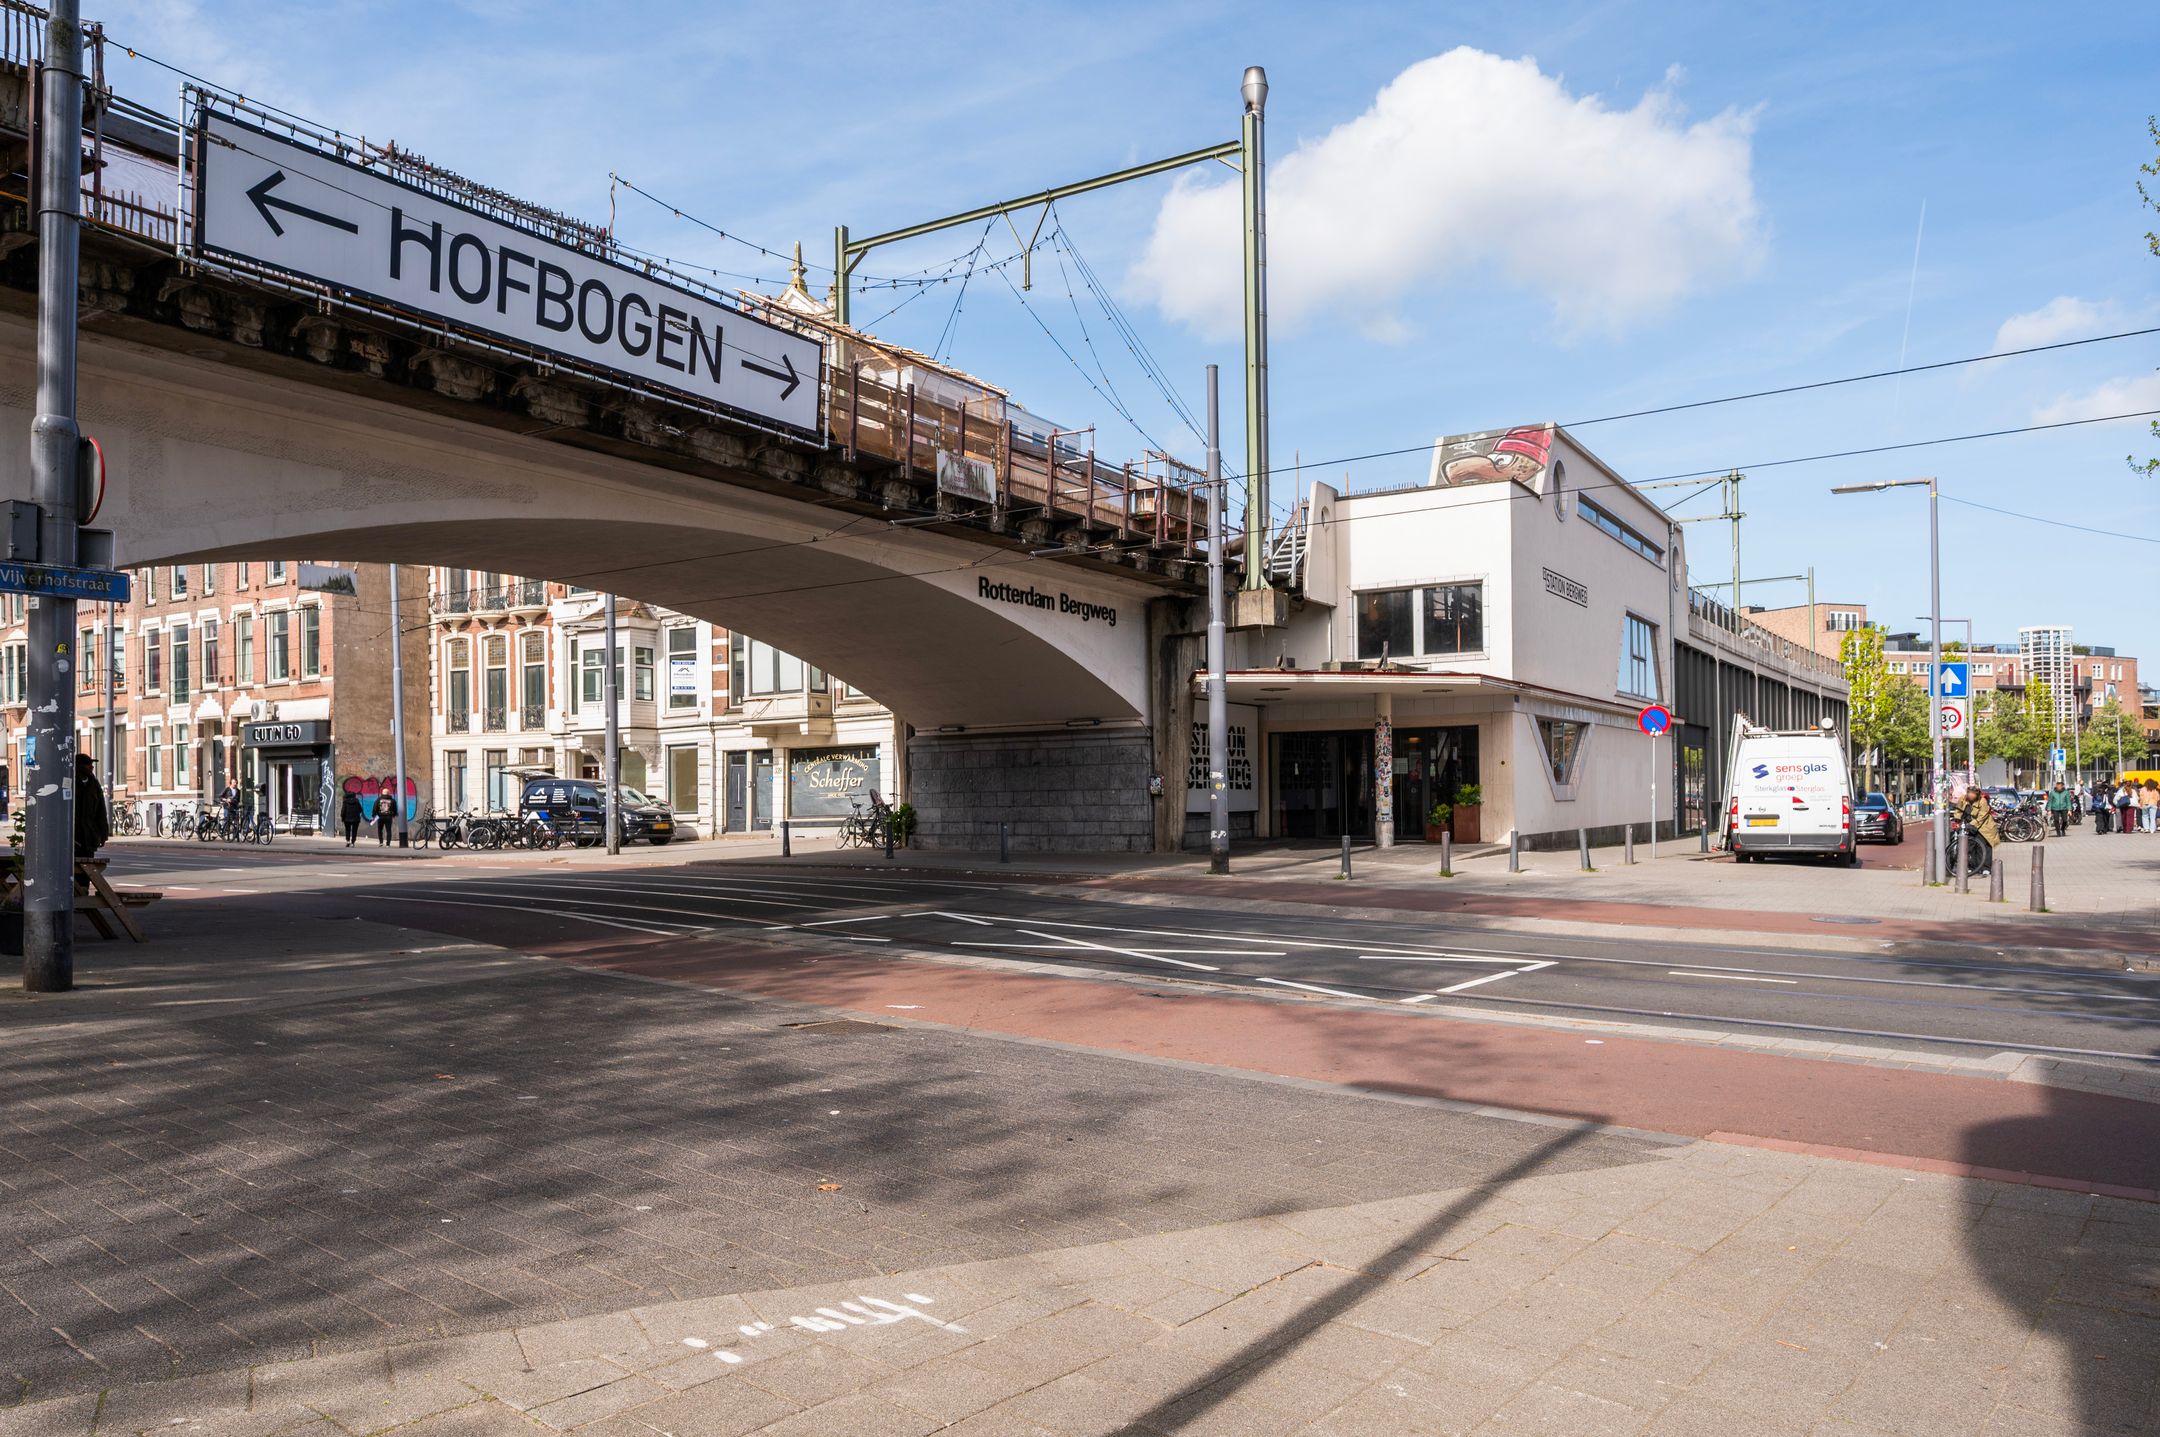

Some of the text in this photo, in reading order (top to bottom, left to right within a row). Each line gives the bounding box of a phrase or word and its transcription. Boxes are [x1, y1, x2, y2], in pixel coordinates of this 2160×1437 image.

[390, 206, 723, 384] HOFBOGEN
[0, 568, 111, 592] Vijverhofstraat
[1546, 573, 1588, 604] STATION BERGWEG
[978, 576, 1116, 627] Rotterdam Bergweg
[1941, 714, 1957, 723] 30
[285, 724, 302, 741] GO
[804, 754, 831, 774] CENTRALE
[831, 753, 869, 771] VERWARMING
[809, 767, 864, 791] Scheffer
[1775, 774, 1803, 783] groep
